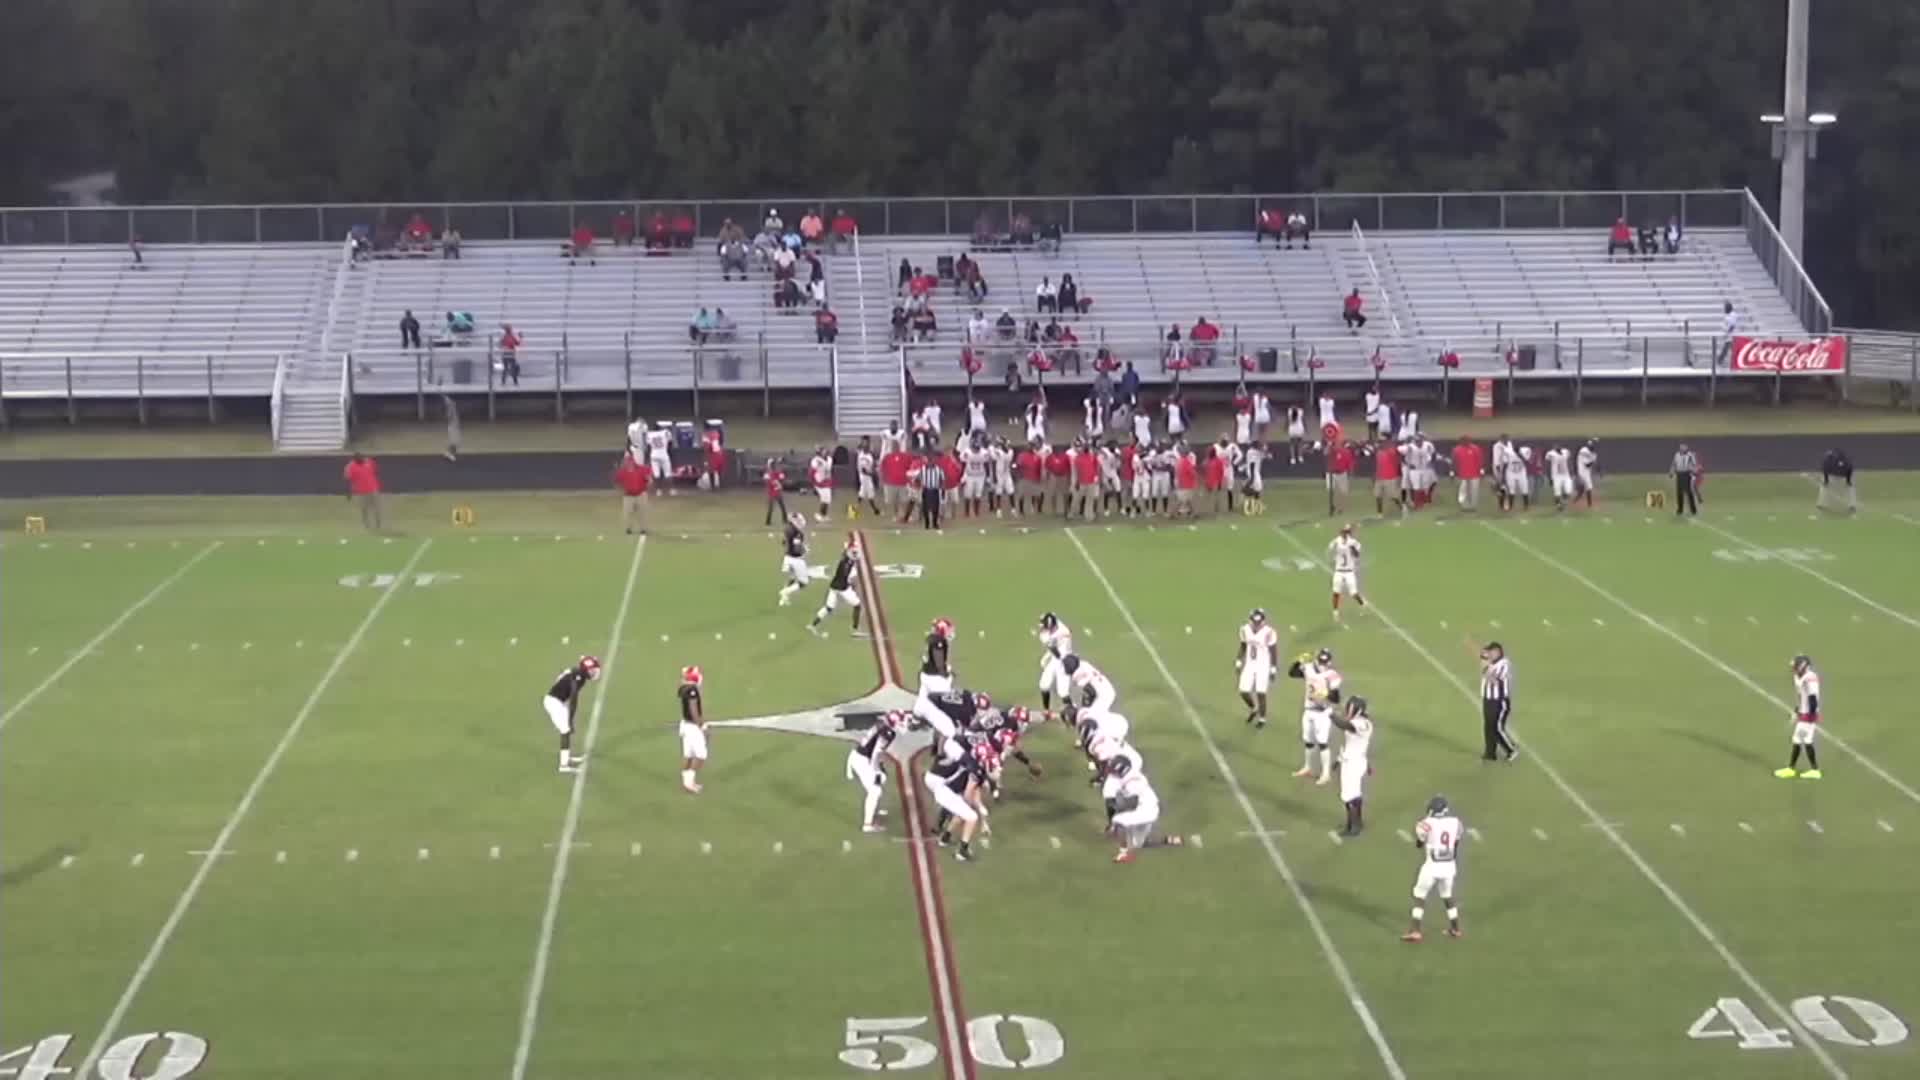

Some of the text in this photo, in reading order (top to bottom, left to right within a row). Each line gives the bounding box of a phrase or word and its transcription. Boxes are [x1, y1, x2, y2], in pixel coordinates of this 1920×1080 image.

[1440, 830, 1450, 849] 9
[839, 1014, 1065, 1070] 50
[1687, 995, 1909, 1049] 40
[0, 1031, 209, 1080] 40
